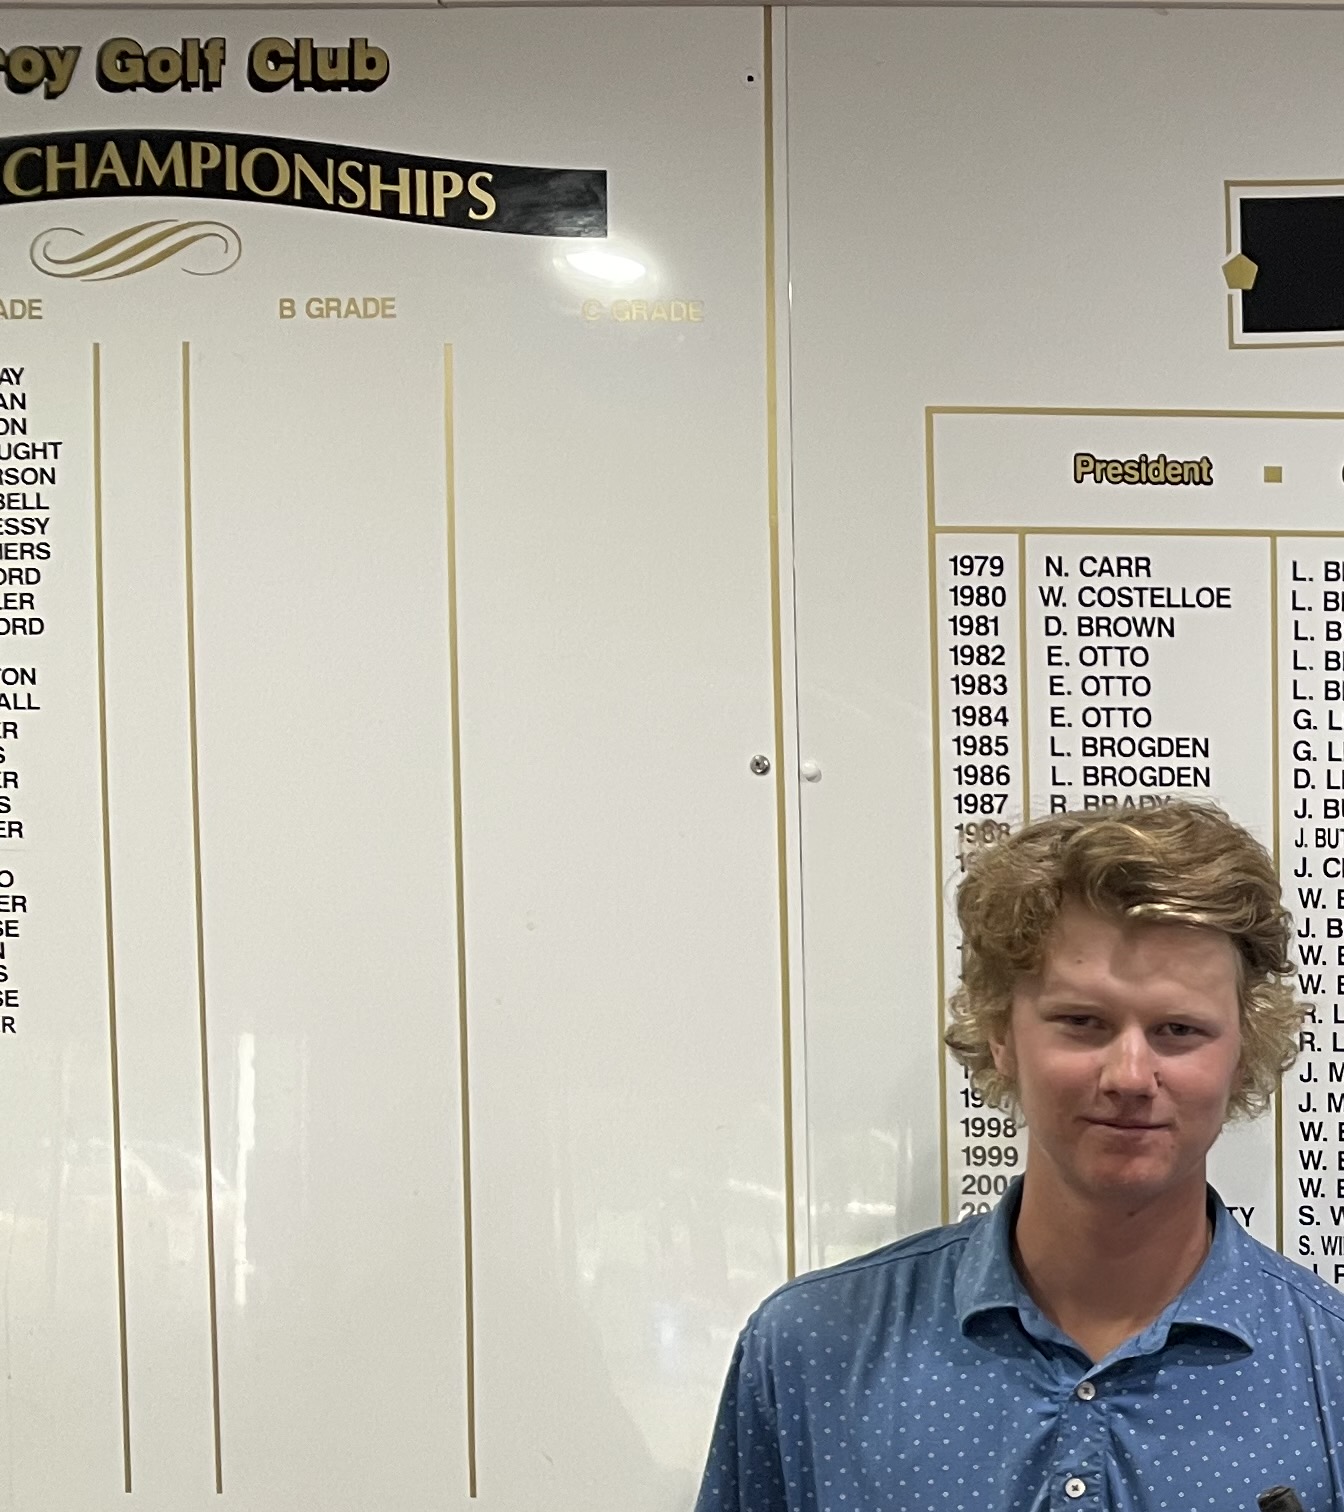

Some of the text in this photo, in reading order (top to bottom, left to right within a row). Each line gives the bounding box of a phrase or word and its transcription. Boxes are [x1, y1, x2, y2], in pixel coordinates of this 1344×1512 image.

[0, 37, 390, 98] oy Golf Club
[3, 140, 497, 220] CHAMPIONSHIPS
[279, 297, 397, 320] B GRADE
[582, 297, 705, 322] C GRADE
[1074, 453, 1213, 486] President
[948, 554, 1005, 578] 1979
[1045, 555, 1152, 578] N. CARR
[1037, 585, 1232, 609] W. COSTELLOE
[1044, 615, 1175, 638] D. BROWN
[948, 644, 1006, 666] 1982
[951, 705, 1010, 727] 1984
[1293, 708, 1318, 731] G.
[1050, 735, 1210, 759] L. BROGDEN
[1293, 767, 1316, 790] D.
[1293, 856, 1313, 878] J.
[1299, 1061, 1318, 1083] J.
[1298, 1205, 1321, 1226] S.
